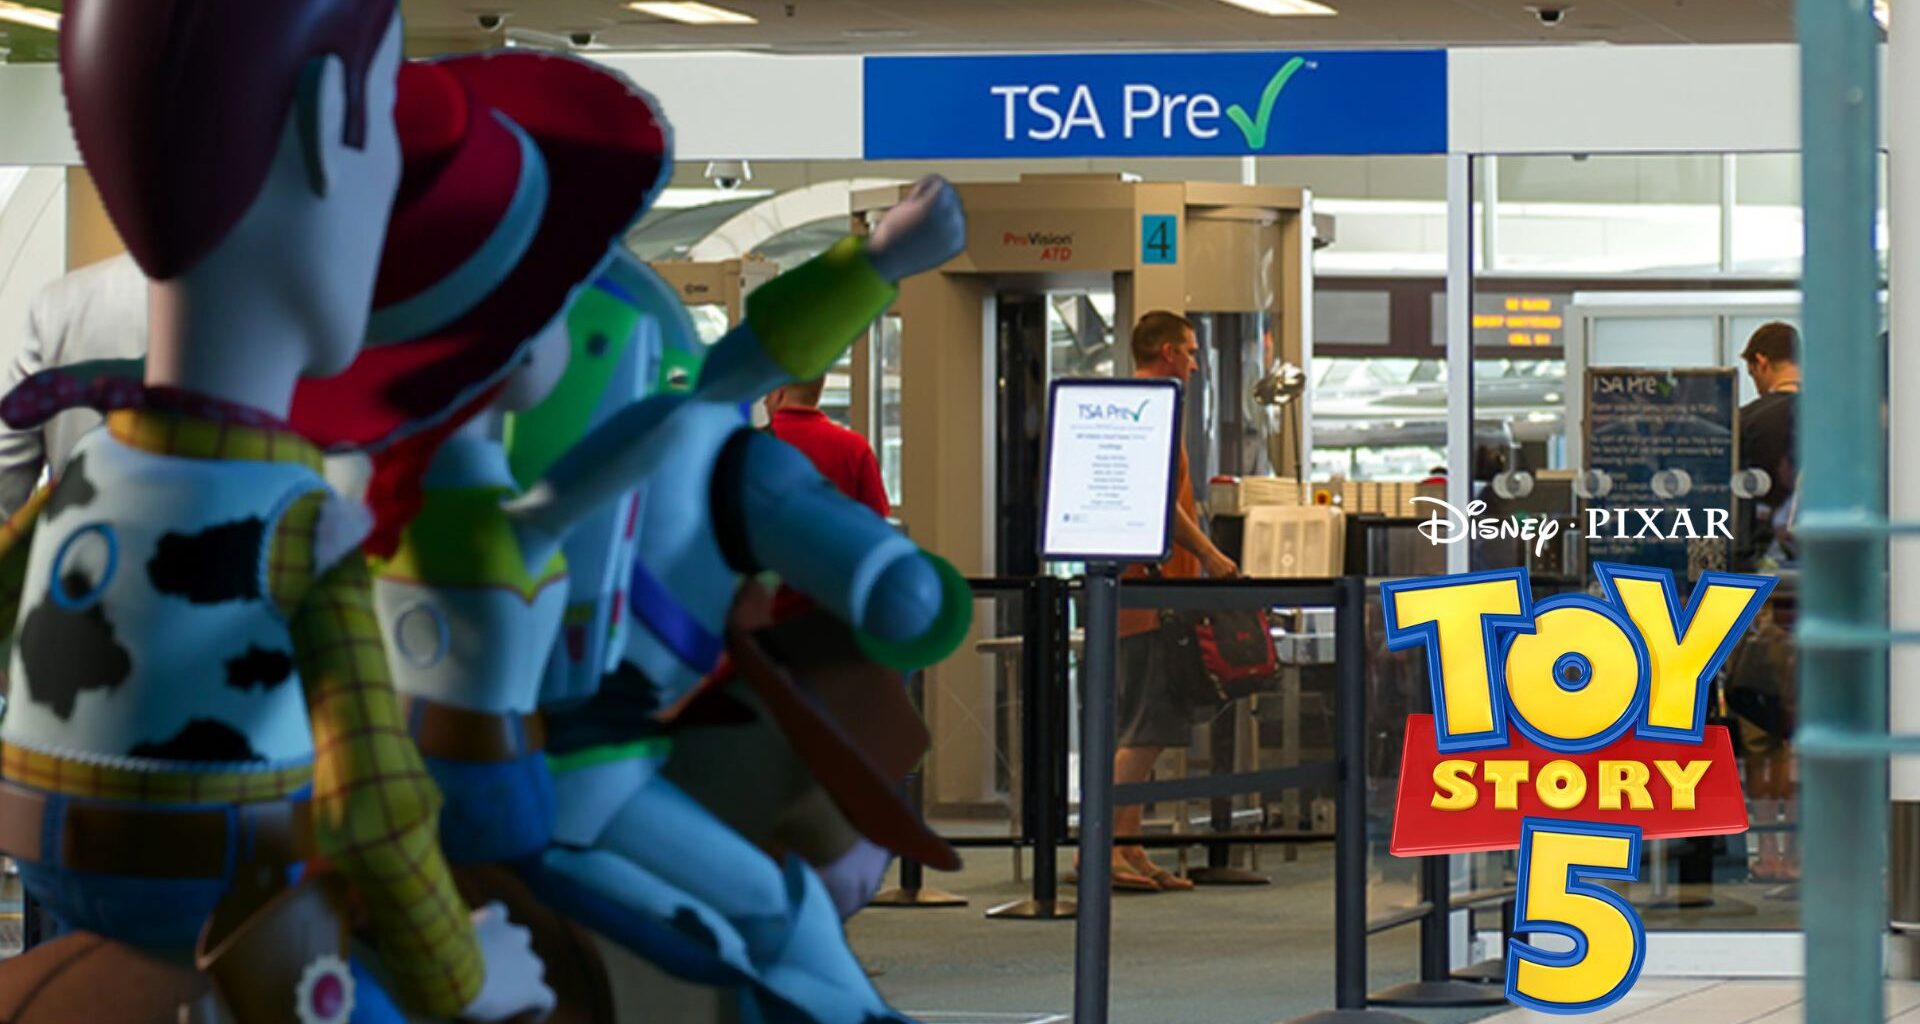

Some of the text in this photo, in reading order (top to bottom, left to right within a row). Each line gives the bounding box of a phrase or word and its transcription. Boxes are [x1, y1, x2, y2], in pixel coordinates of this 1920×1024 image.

[989, 84, 1106, 140] TSA
[1123, 84, 1221, 139] Pre
[1003, 231, 1073, 246] ProVision
[1147, 221, 1171, 259] 4
[1041, 247, 1073, 262] ATD
[1079, 403, 1131, 420] TSA Pre
